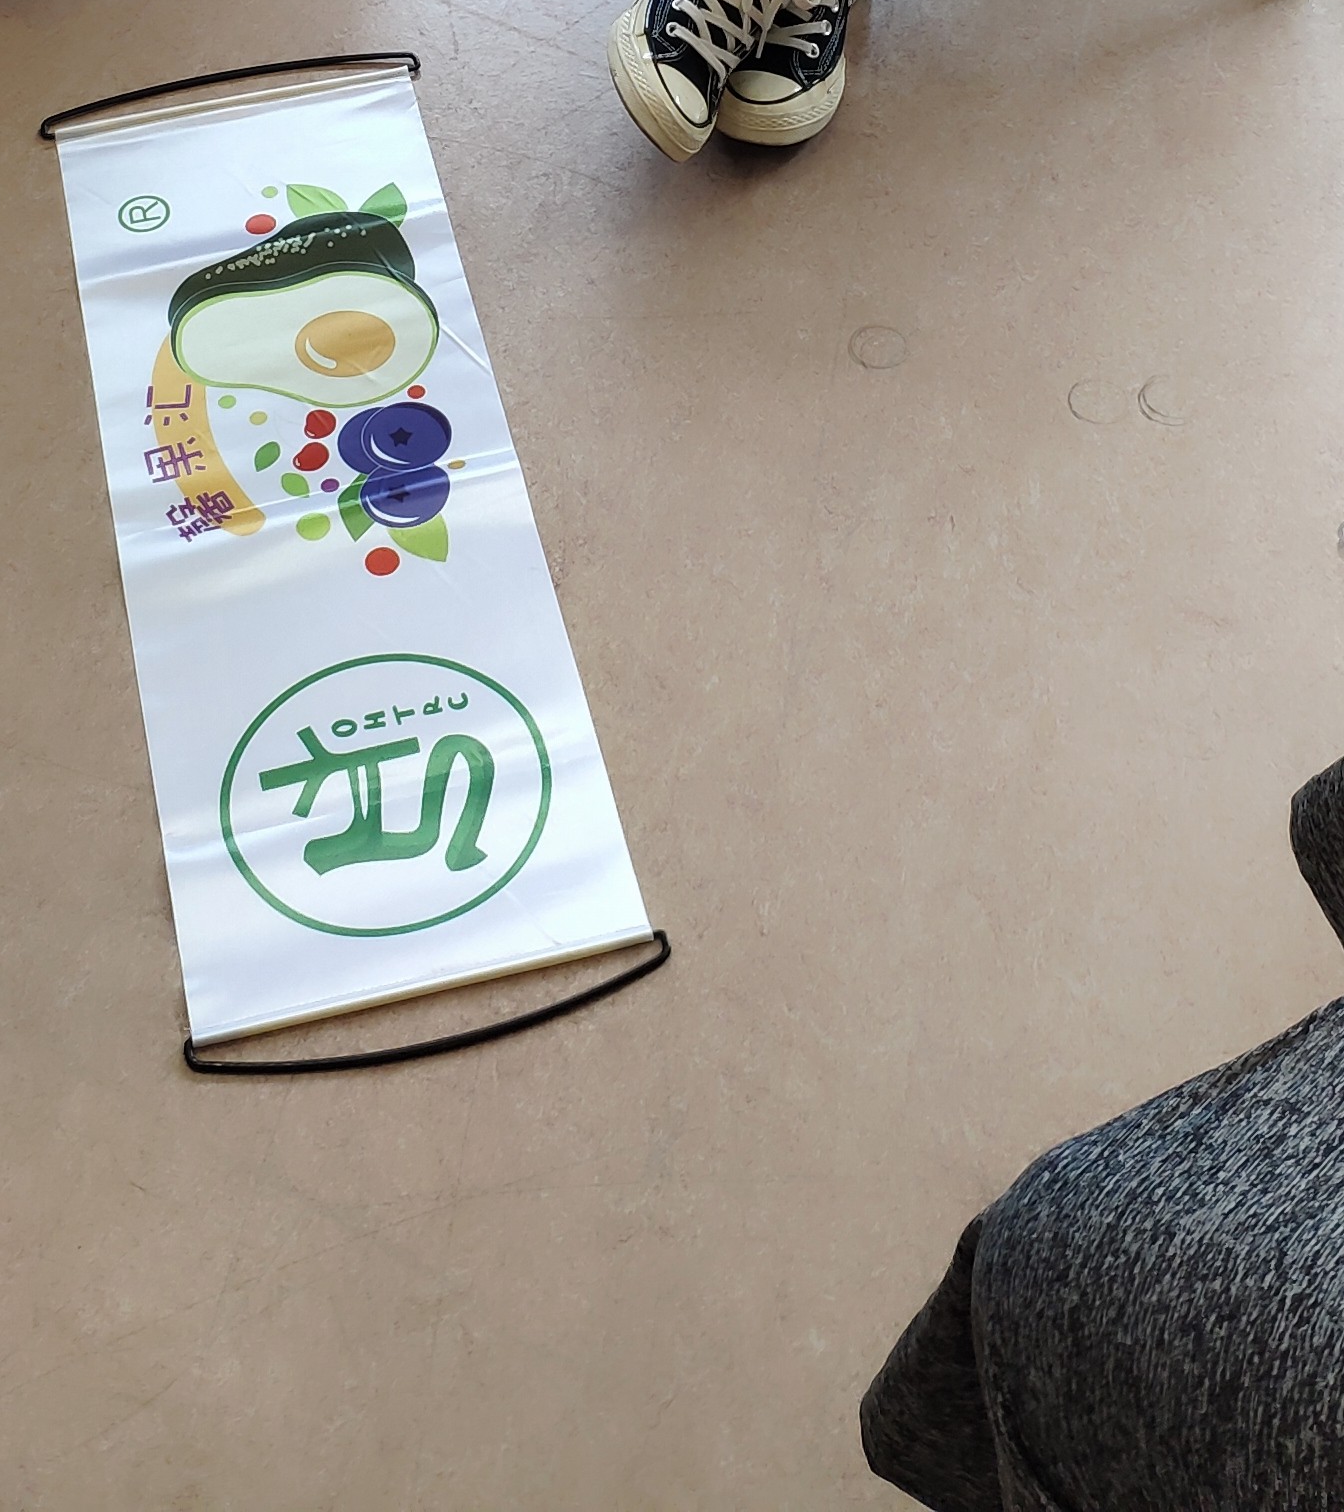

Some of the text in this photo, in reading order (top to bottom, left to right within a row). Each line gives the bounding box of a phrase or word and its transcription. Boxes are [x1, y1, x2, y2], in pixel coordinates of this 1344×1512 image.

[143, 383, 236, 543] 馨果汇
[331, 692, 469, 738] OHTRC
